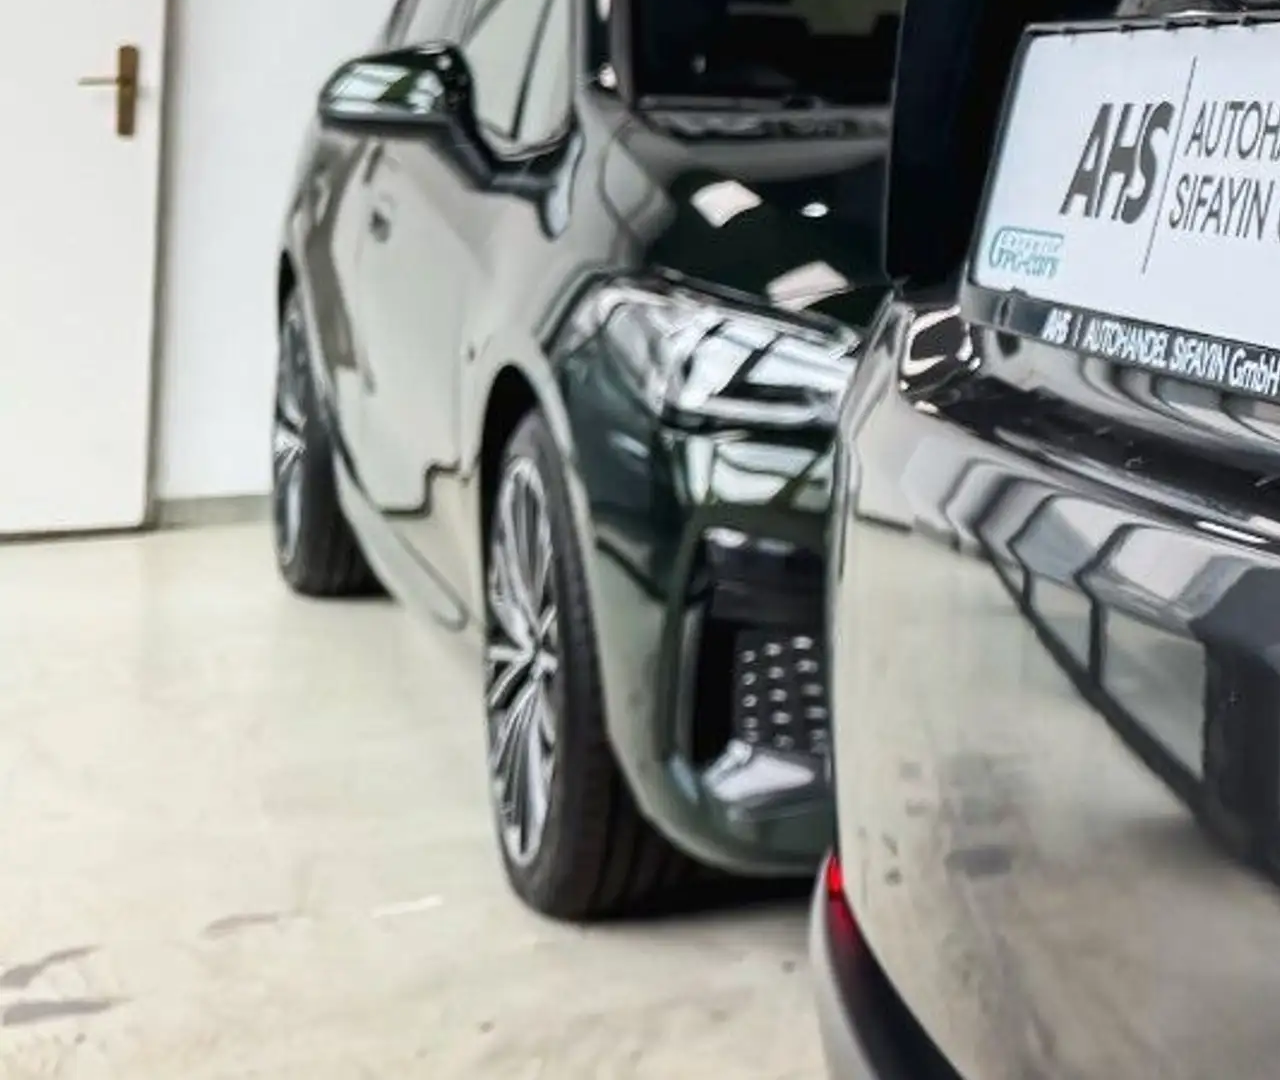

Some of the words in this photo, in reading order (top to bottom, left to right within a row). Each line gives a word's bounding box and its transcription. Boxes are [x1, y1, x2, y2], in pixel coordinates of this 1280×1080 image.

[1060, 102, 1174, 223] AHS
[1170, 174, 1275, 240] SIFAYIN
[1082, 317, 1170, 369] AUTOHANDEL
[1169, 335, 1230, 383] SIFAYIN
